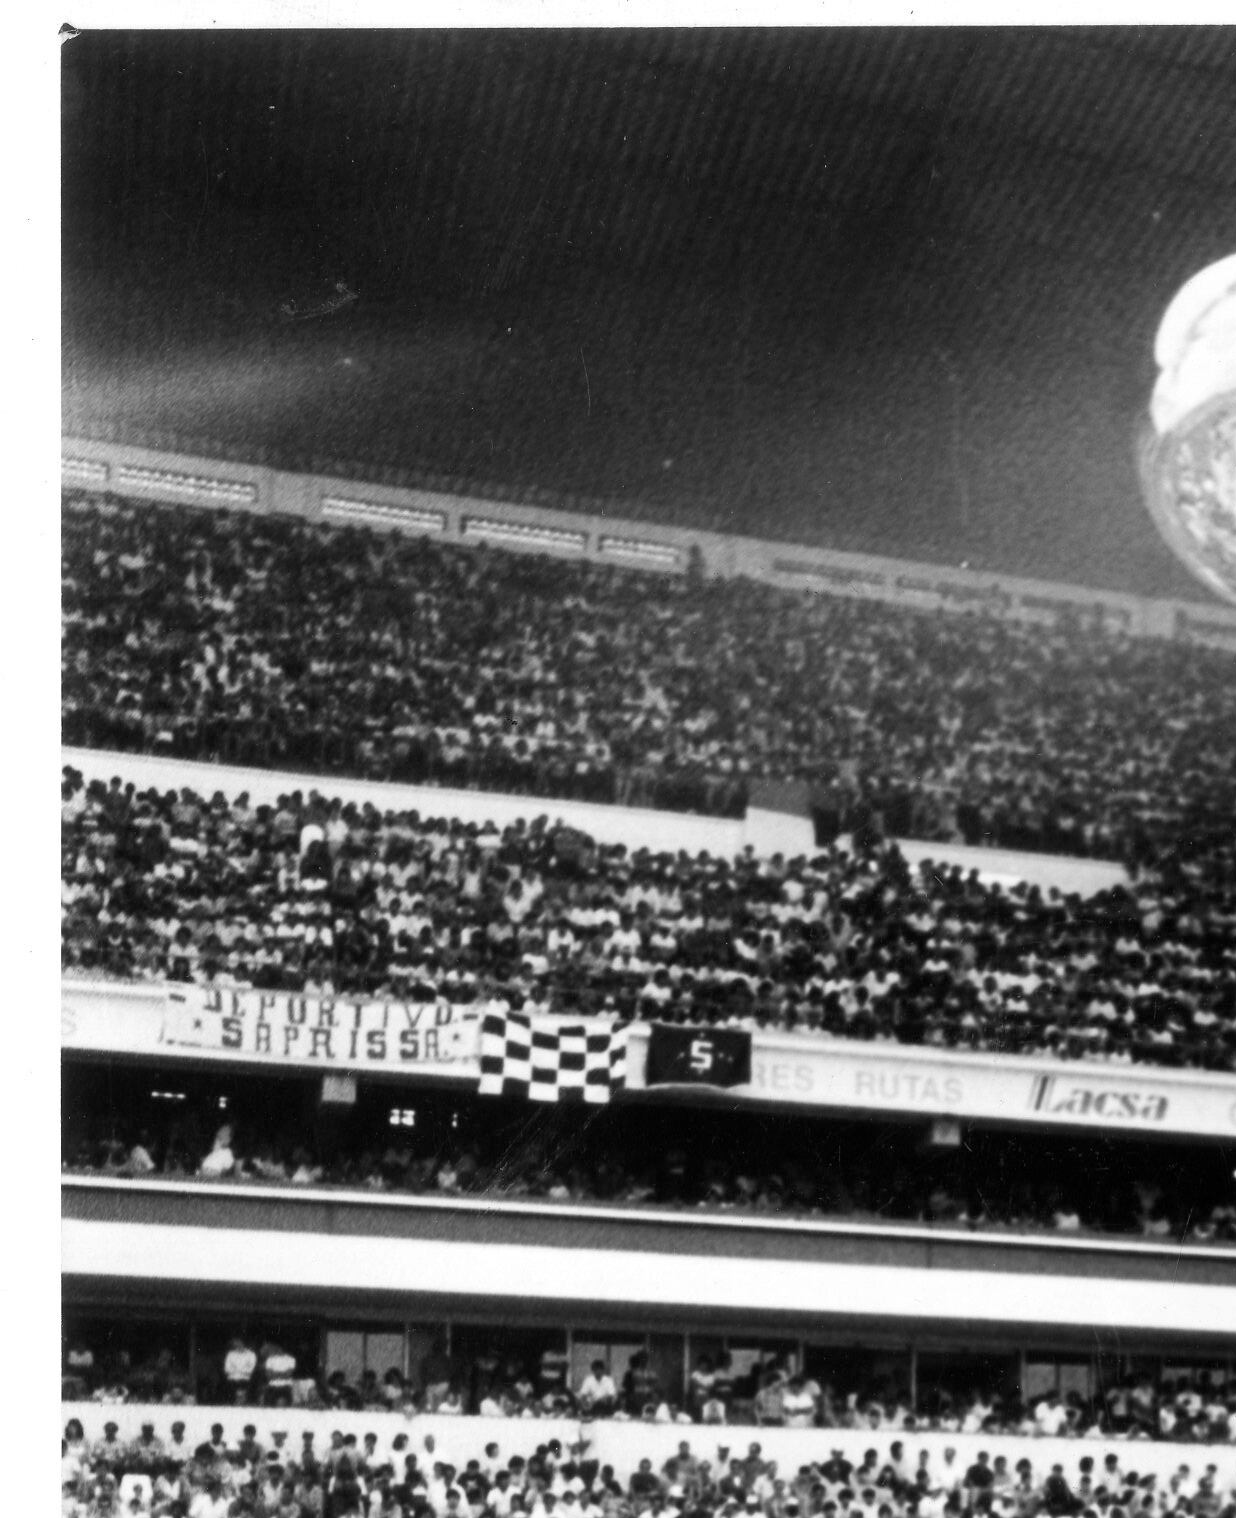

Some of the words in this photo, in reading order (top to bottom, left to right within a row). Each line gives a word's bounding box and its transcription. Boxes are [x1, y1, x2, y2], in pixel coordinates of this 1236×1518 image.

[221, 1017, 445, 1060] SAPRISSA
[753, 1062, 814, 1092] RES
[854, 1069, 964, 1104] RUTAS
[1028, 1074, 1168, 1121] Lacsa
